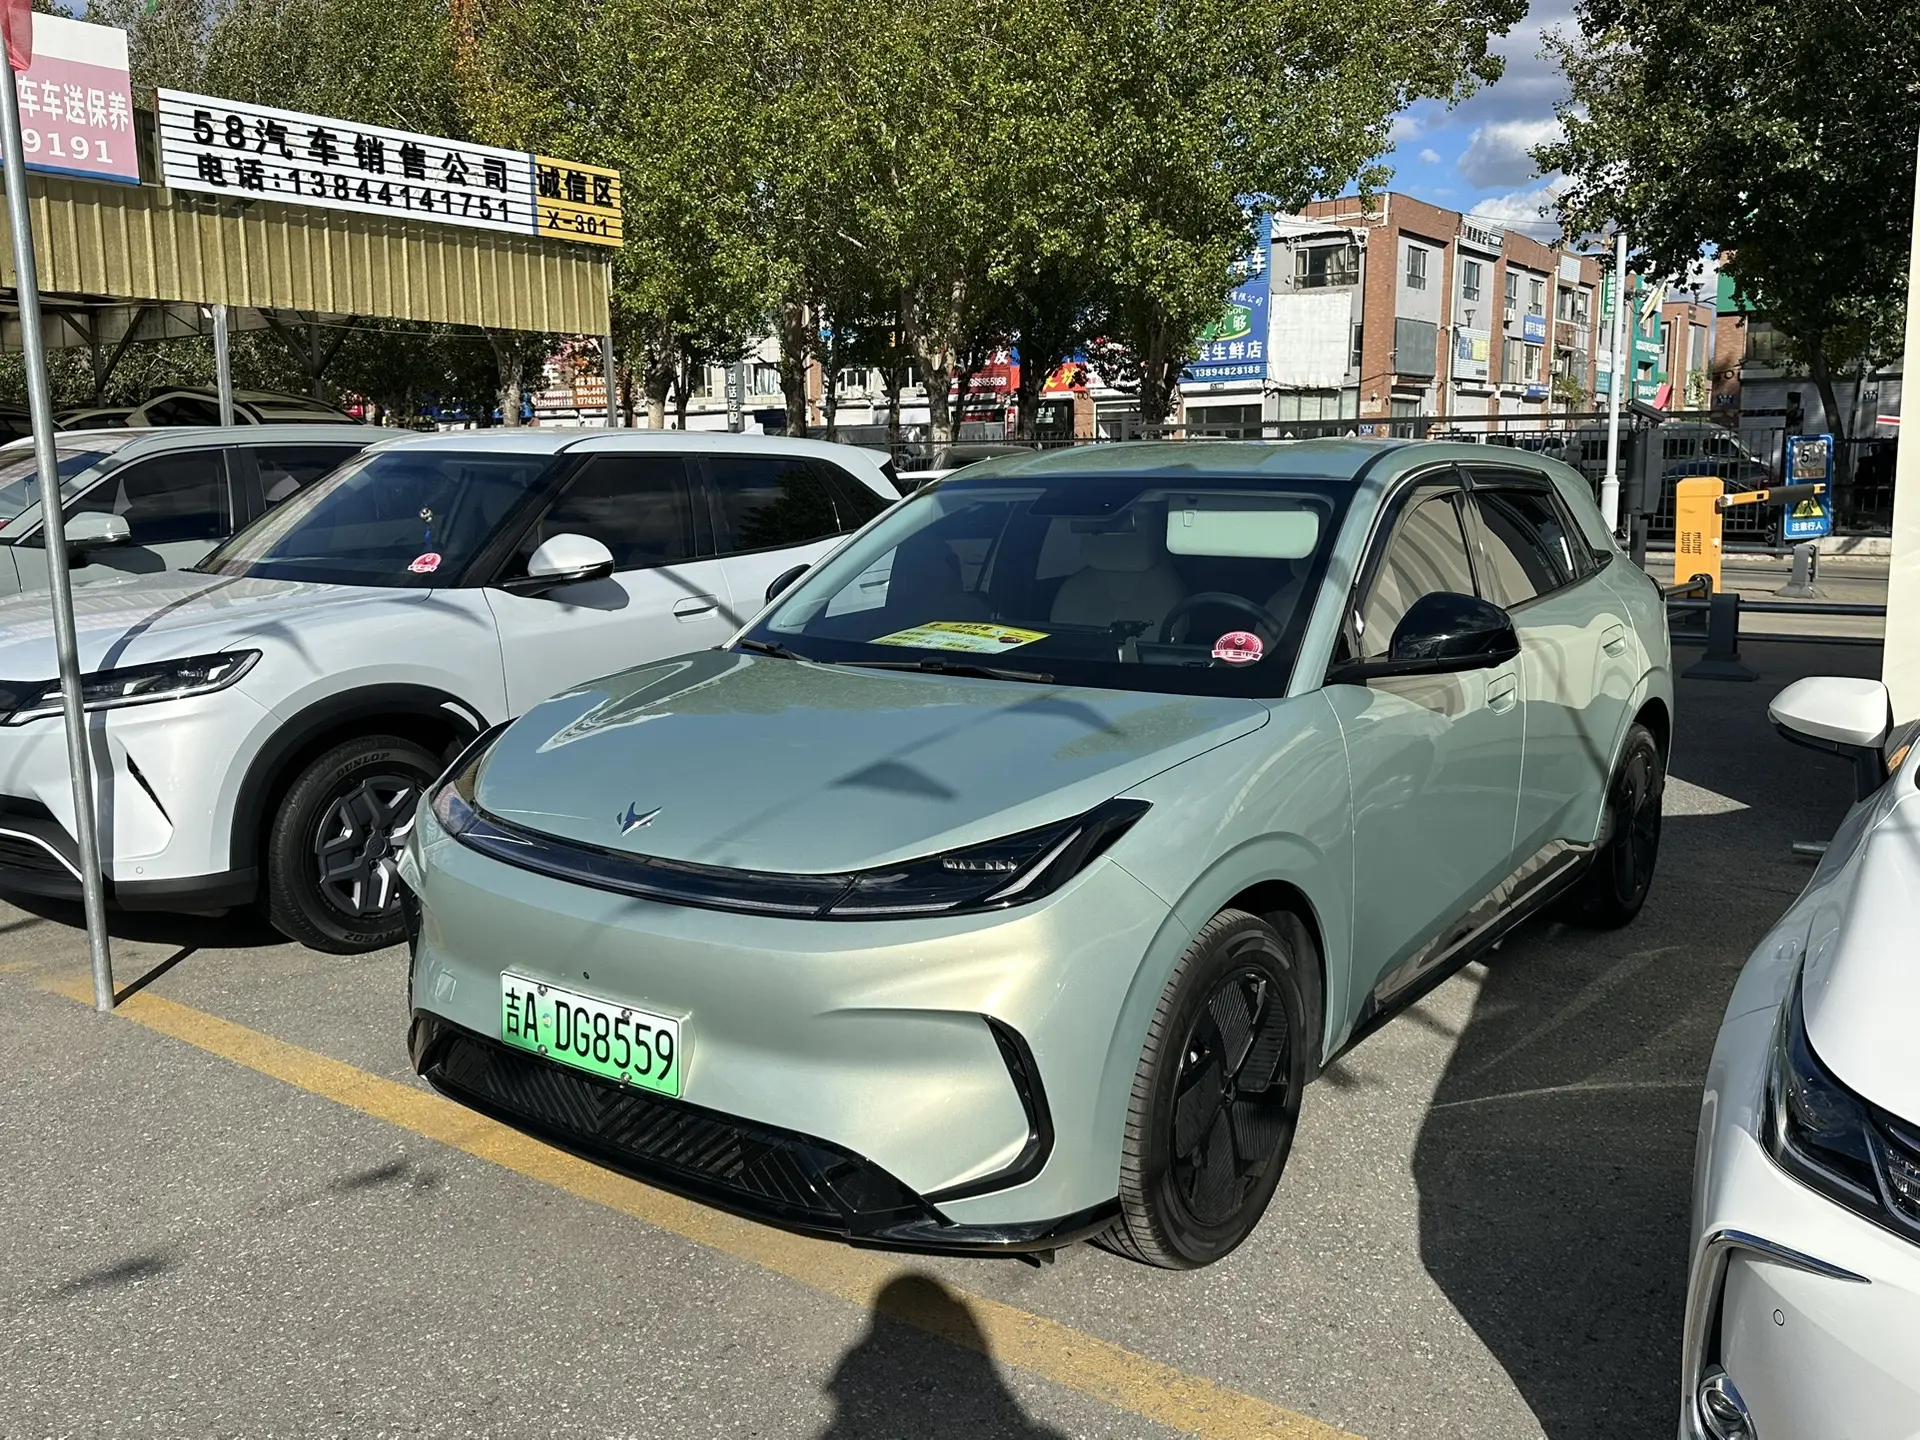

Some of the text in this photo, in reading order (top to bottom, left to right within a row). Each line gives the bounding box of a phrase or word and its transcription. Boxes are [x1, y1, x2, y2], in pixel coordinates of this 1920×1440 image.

[21, 128, 114, 164] 9191
[193, 109, 508, 194] 58汽车销售公司
[536, 164, 614, 207] 诚信区
[547, 210, 608, 236] X-301
[1195, 366, 1260, 378] 13894828188
[1791, 521, 1824, 532] 注意行人
[336, 752, 390, 779] DUNLOP
[505, 987, 674, 1081] 吉A DG8559
